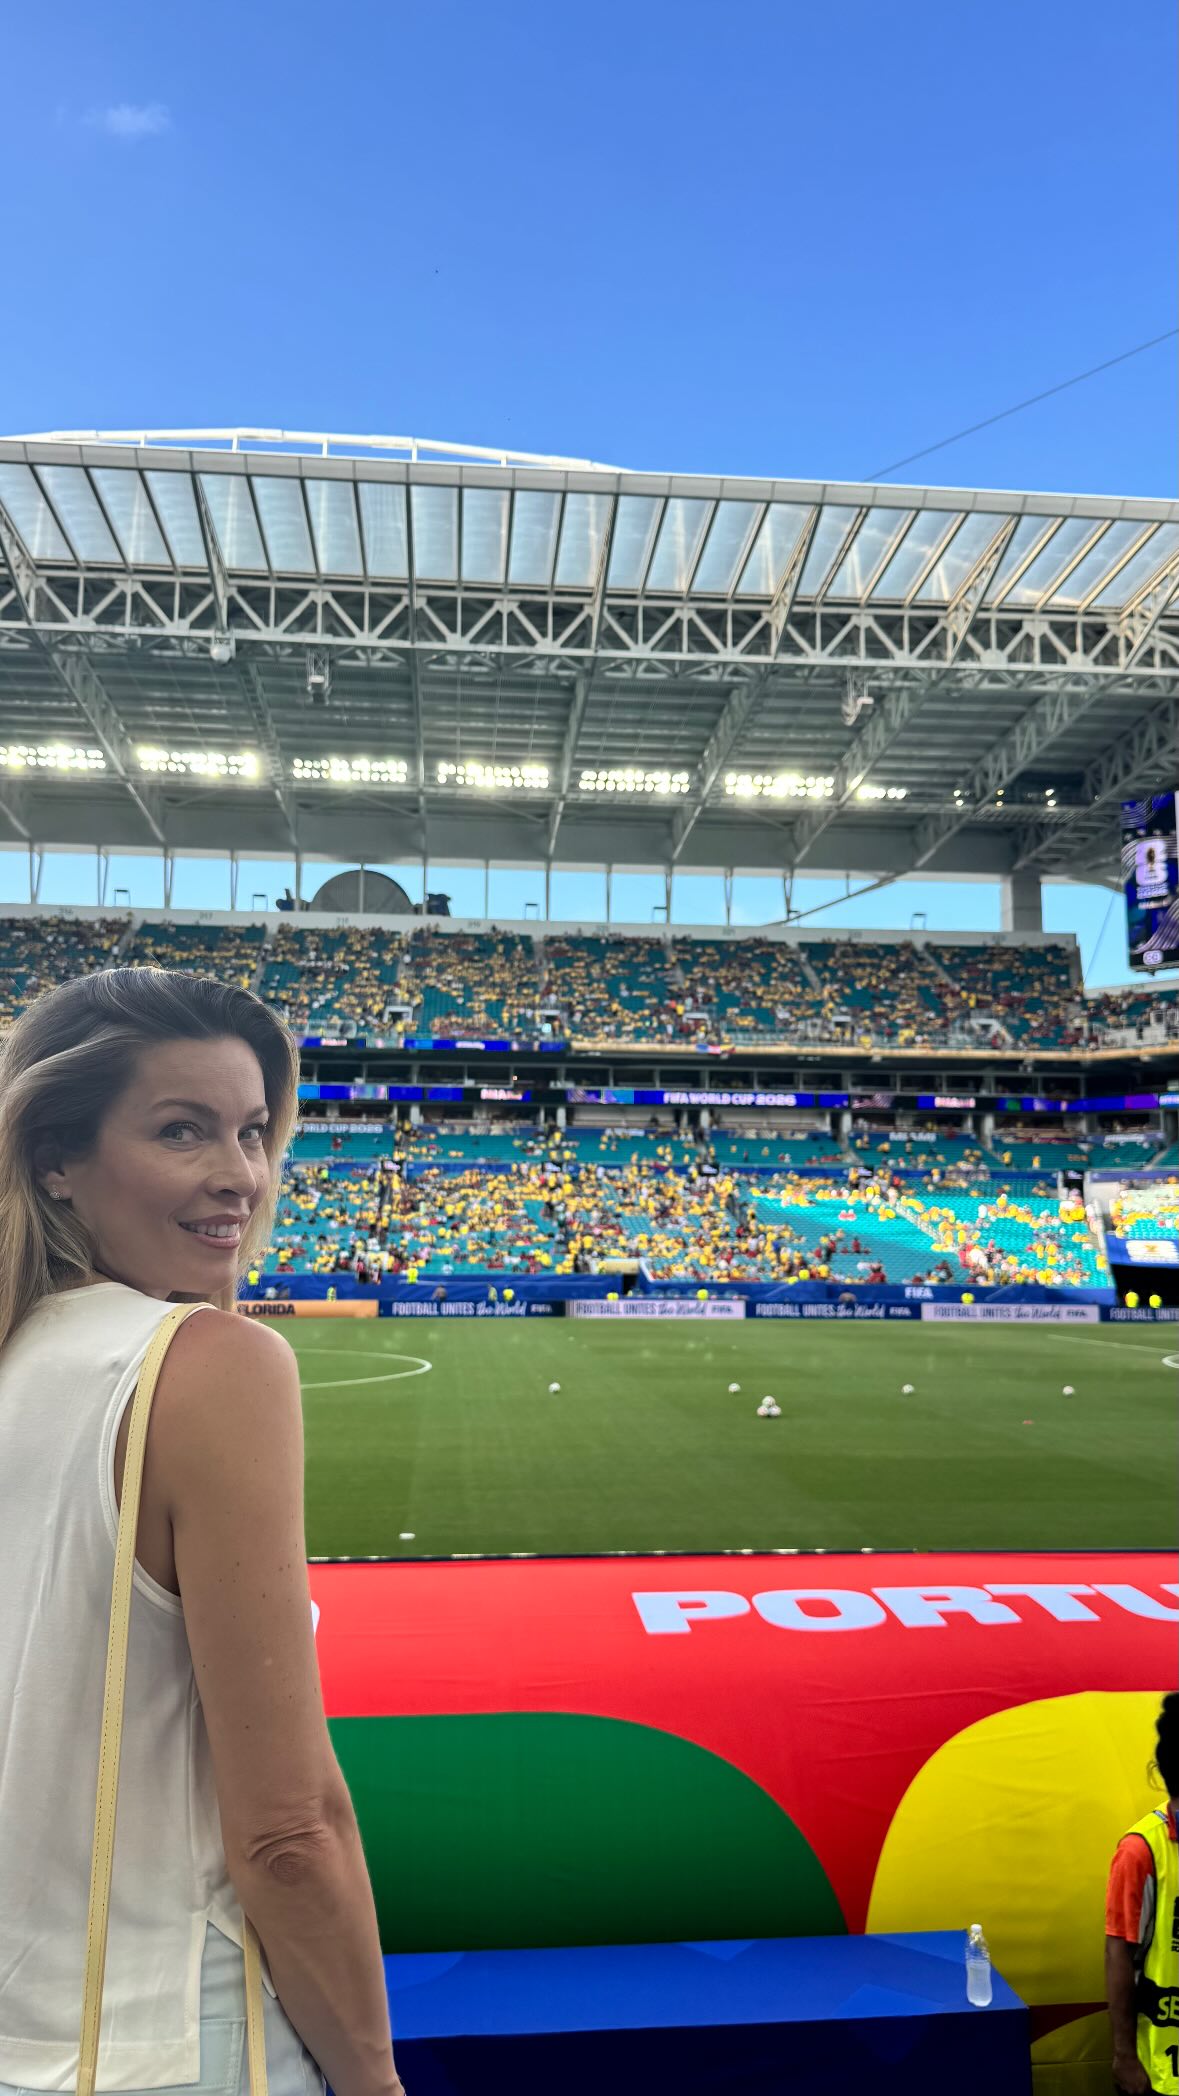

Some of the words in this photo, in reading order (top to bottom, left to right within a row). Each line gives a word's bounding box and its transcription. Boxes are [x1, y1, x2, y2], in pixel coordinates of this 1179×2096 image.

[663, 1092, 688, 1104] FIFA
[689, 1092, 730, 1105] WORLD
[731, 1093, 754, 1105] CUP
[755, 1094, 796, 1107] 2026
[905, 1286, 933, 1300] FIFA
[391, 1302, 438, 1316] FOOTBALL
[440, 1302, 475, 1316] UNITES
[494, 1300, 527, 1316] World
[576, 1302, 622, 1315] FOOTBALL
[623, 1302, 657, 1315] UNITES
[755, 1303, 801, 1317] FOOTBALL
[802, 1304, 836, 1317] UNITES
[853, 1302, 886, 1318] World
[933, 1305, 977, 1318] FOOTBALL
[979, 1305, 1013, 1318] UNITES
[1109, 1308, 1154, 1321] FOOTBALL
